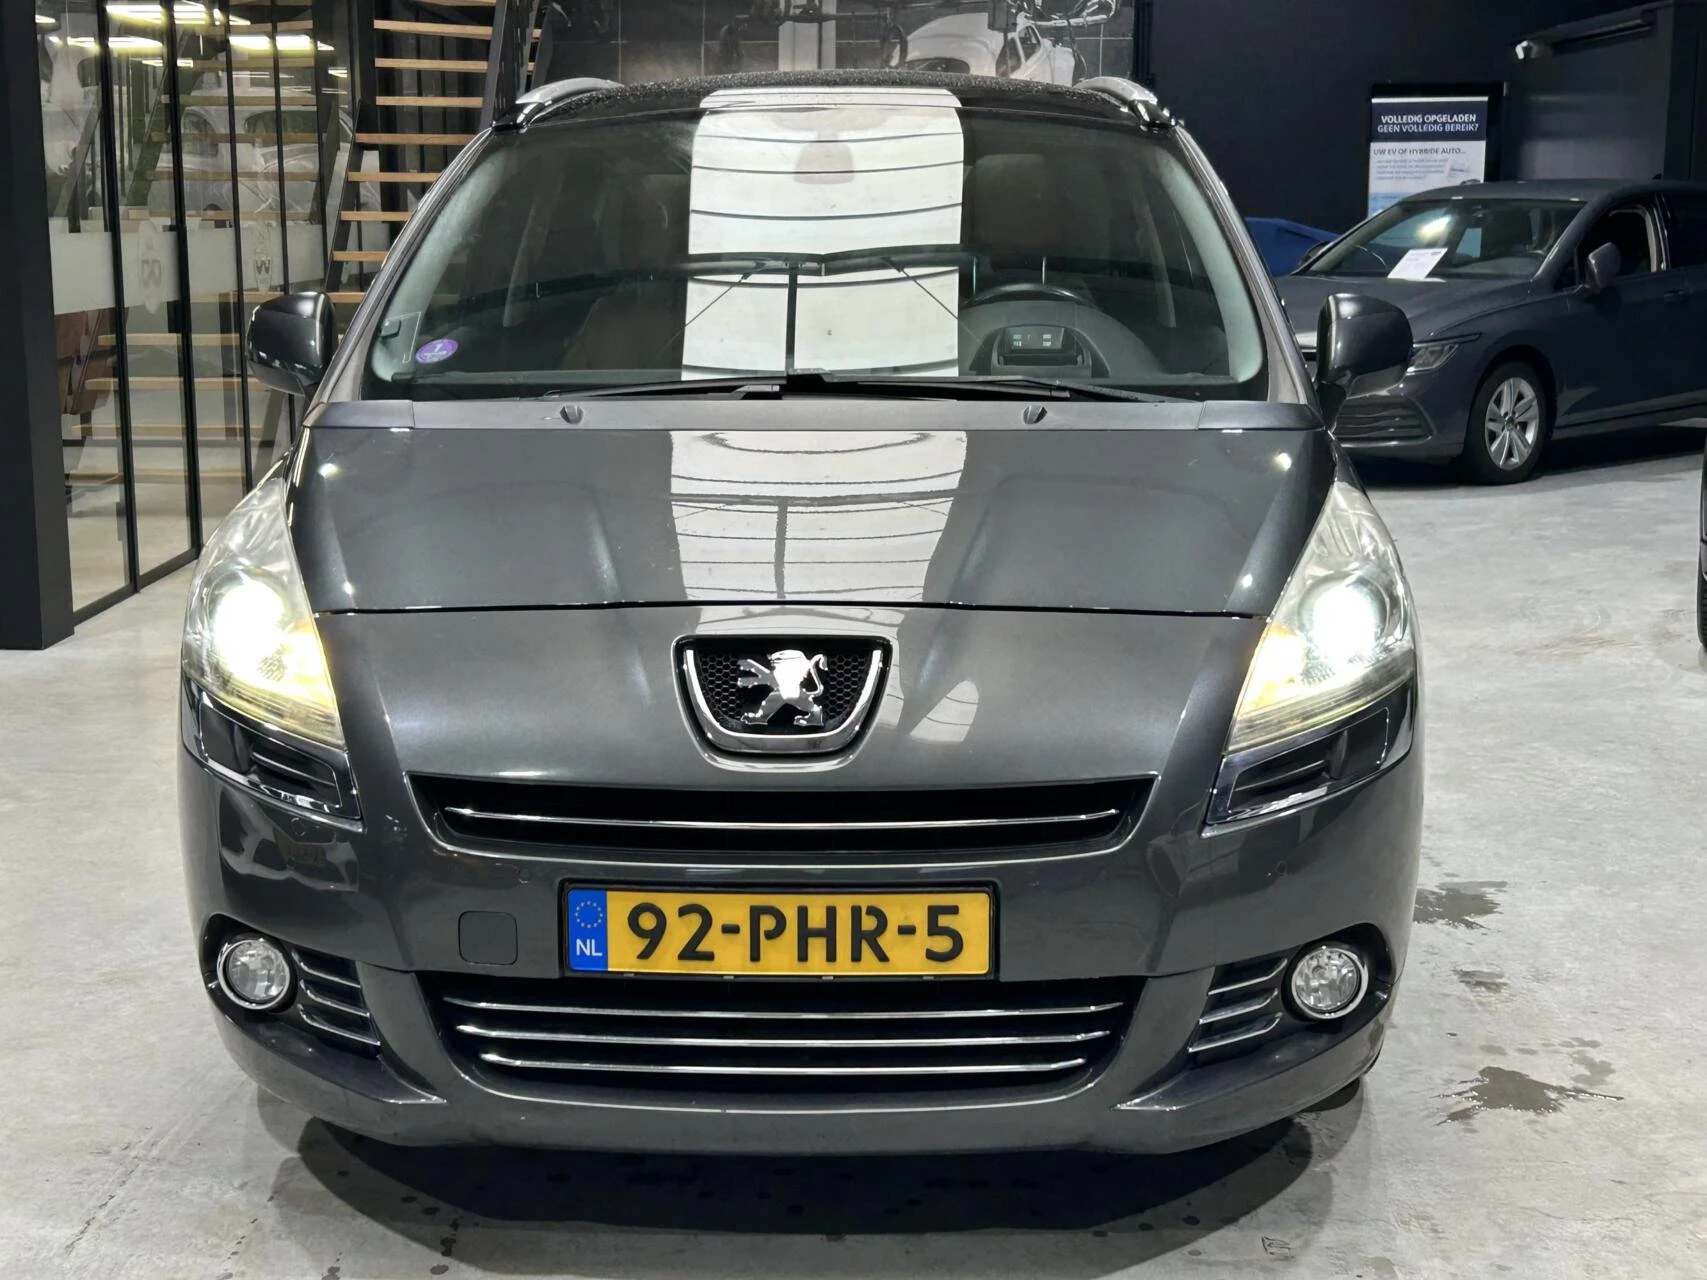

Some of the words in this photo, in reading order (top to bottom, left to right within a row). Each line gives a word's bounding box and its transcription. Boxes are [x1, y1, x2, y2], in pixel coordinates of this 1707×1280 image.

[1381, 114, 1422, 124] VOLLEDIG
[1424, 113, 1476, 123] OPGELADEN
[1377, 124, 1400, 133] GEEN
[1402, 124, 1443, 132] VOLLEDIG
[1445, 123, 1479, 132] BEREIK?
[627, 902, 964, 963] 92-PHR-5
[576, 938, 603, 957] NL
